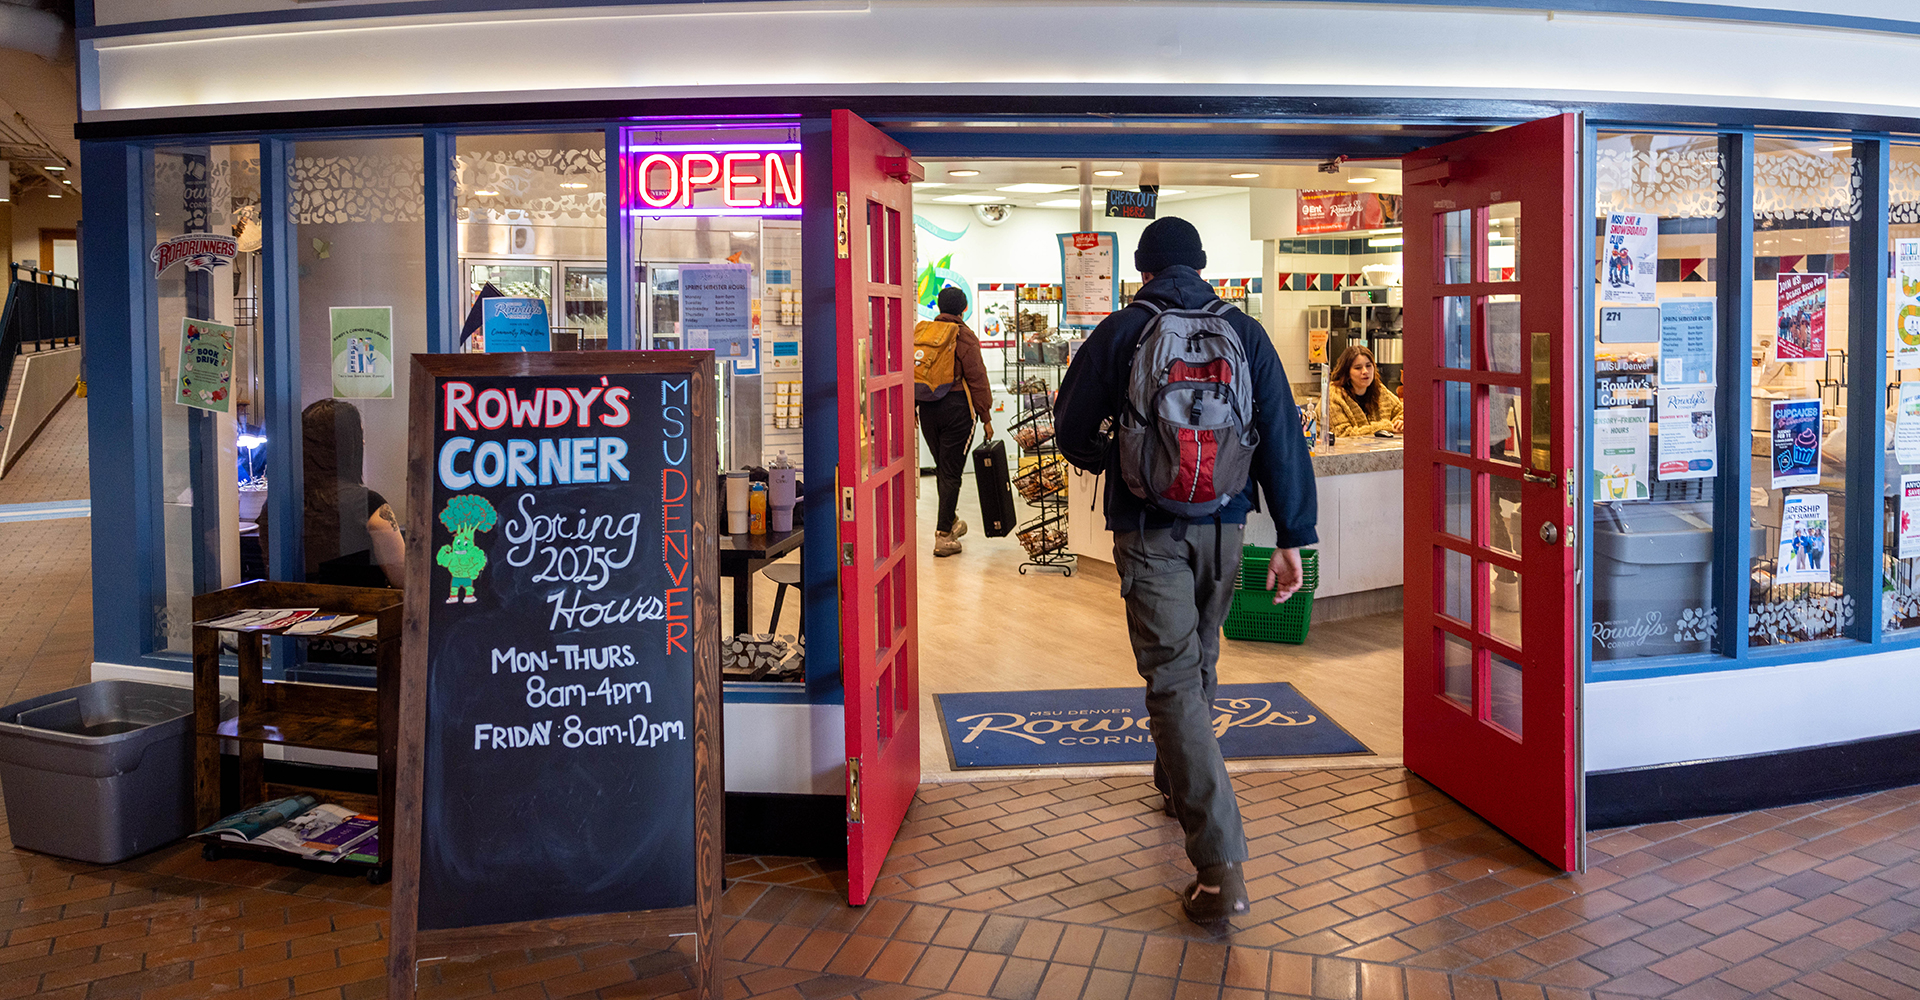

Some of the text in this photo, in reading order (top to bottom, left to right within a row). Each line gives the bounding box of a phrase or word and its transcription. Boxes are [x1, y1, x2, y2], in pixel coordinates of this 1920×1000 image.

[638, 152, 802, 207] OPEN
[1110, 190, 1157, 207] CHECK OUT
[1122, 206, 1146, 217] HERE
[1309, 205, 1323, 213] Ent
[1611, 214, 1624, 225] MSU
[1624, 215, 1636, 226] SKI
[1610, 224, 1648, 236] SNOWBOARD
[1609, 234, 1625, 245] CLUB
[156, 240, 236, 271] ROADRUNNERS
[1779, 279, 1792, 293] JOIN
[1606, 312, 1621, 321] 271
[197, 348, 219, 358] BOOK
[196, 356, 219, 367] DRIVE
[1601, 361, 1651, 371] MSU Denver
[1601, 378, 1650, 393] Rowdy's
[442, 376, 631, 431] ROWDY'S
[1601, 394, 1640, 406] Corner
[1667, 390, 1708, 410] Rowdy's
[1775, 407, 1818, 419] CUPCAKES
[661, 379, 688, 465] MSU
[438, 436, 630, 490] CORNER
[504, 493, 641, 569] Spring
[531, 544, 609, 592] 2025
[661, 468, 689, 656] DENVER
[546, 589, 665, 631] Hours
[1591, 610, 1668, 648] Rowdy's
[1607, 641, 1635, 649] CORNER
[491, 644, 640, 674] MON-THURS.
[526, 675, 652, 708] 8am-4pm
[956, 697, 1317, 745] Rowy's
[1058, 735, 1155, 746] CORNE
